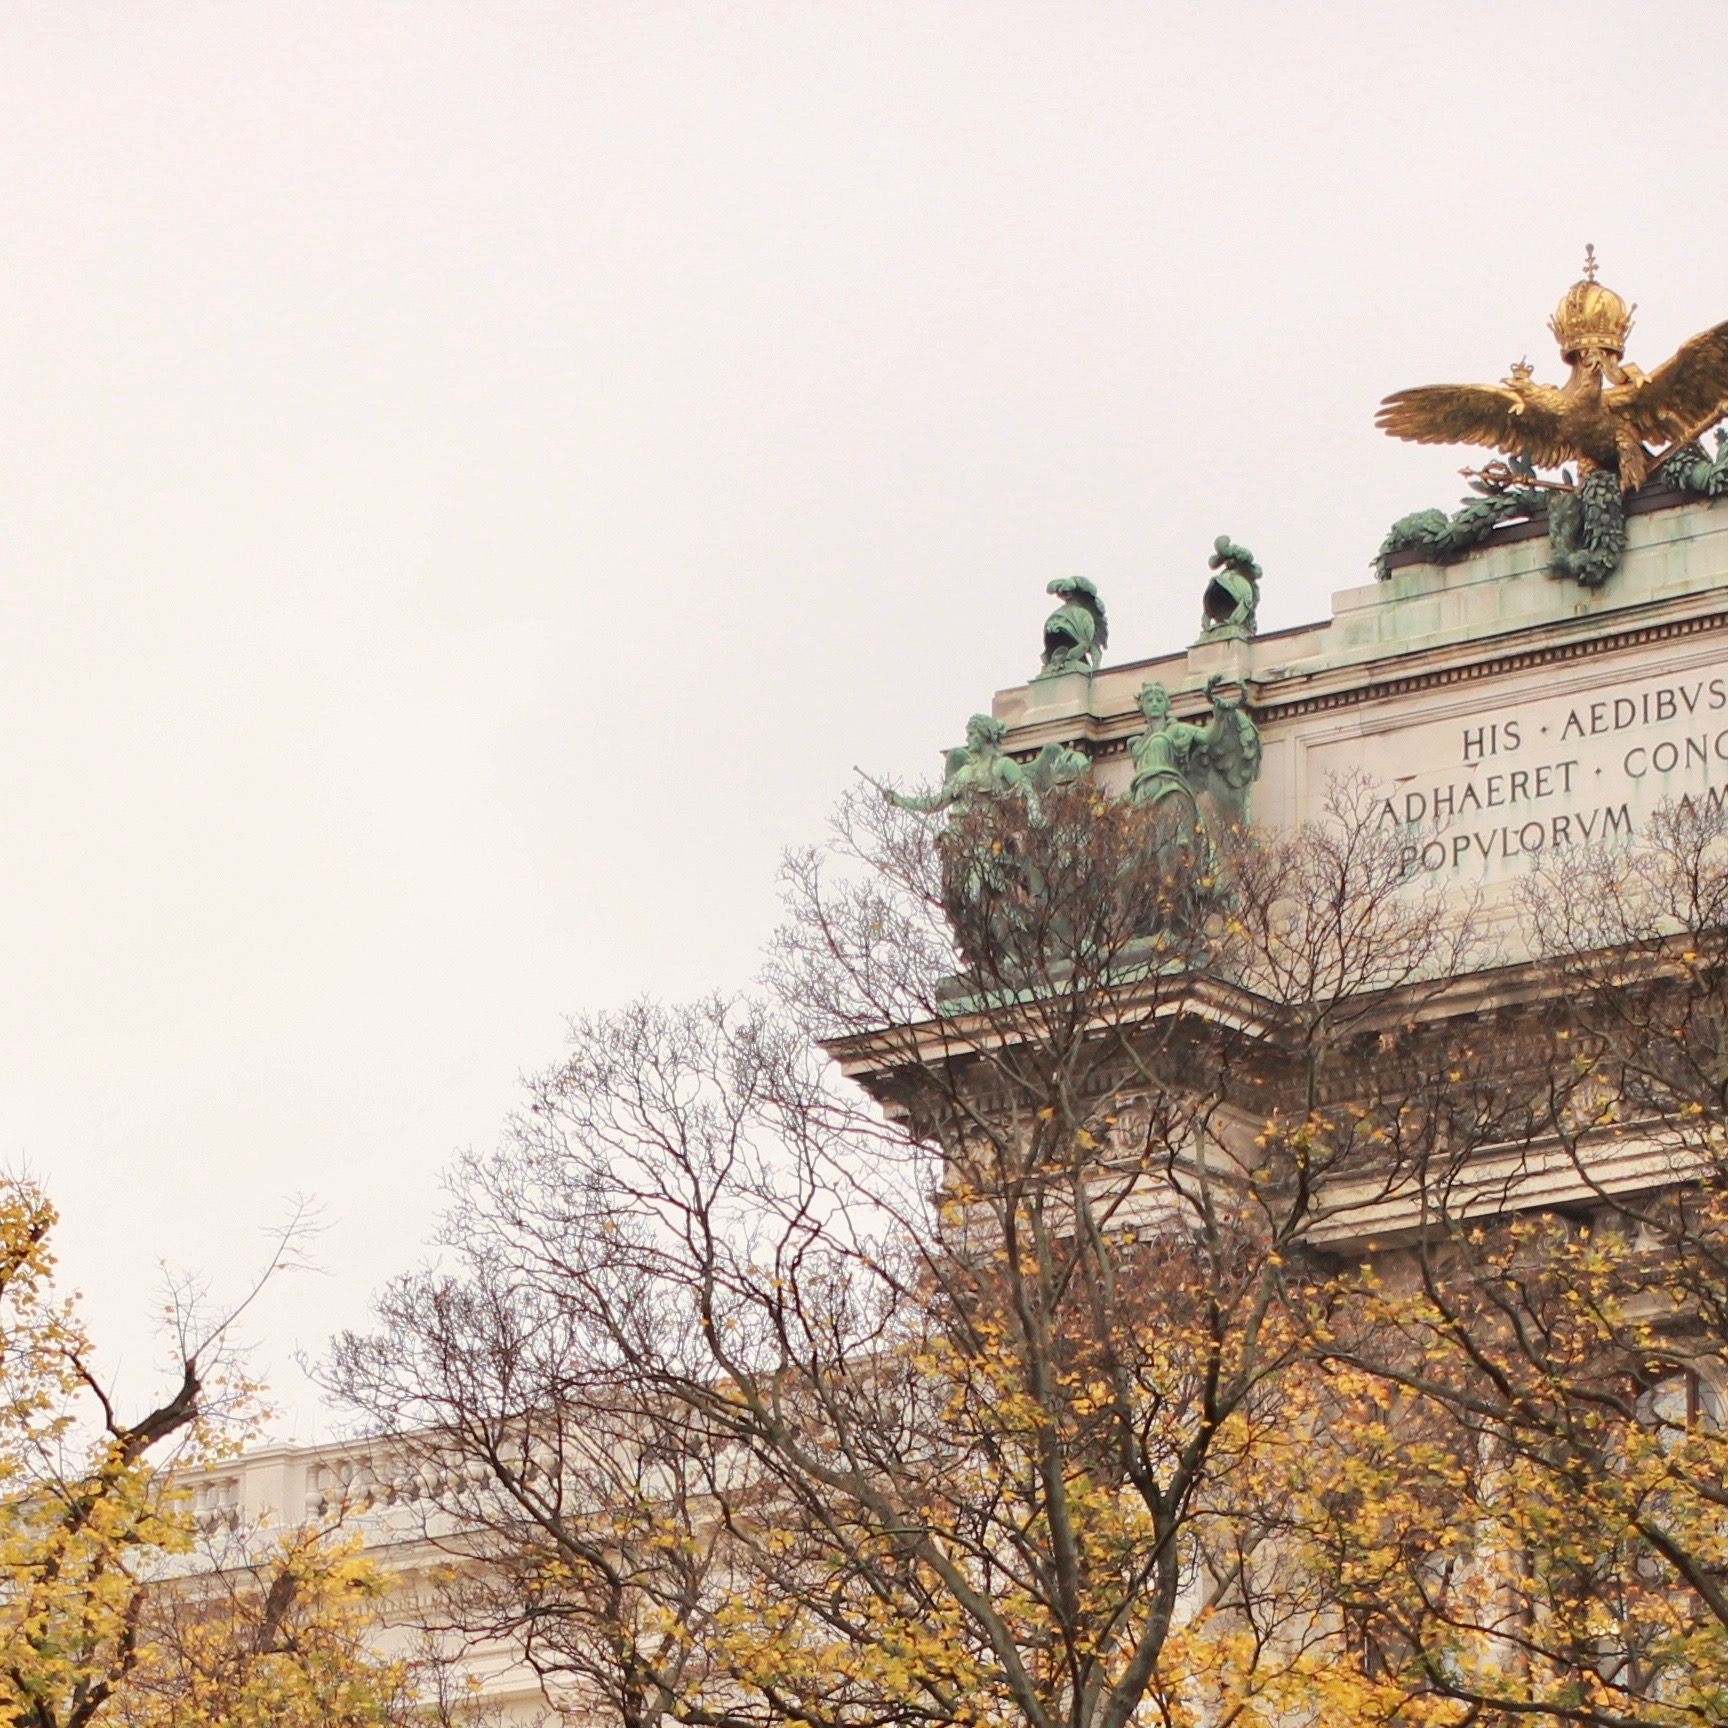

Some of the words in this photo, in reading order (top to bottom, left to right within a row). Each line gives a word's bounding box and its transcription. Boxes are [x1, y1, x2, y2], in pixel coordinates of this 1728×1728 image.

[1462, 720, 1521, 761] HIS
[1560, 678, 1727, 741] AEDIBVS
[1377, 759, 1578, 831] ADHAERET
[1400, 803, 1634, 876] POPVLORVM
